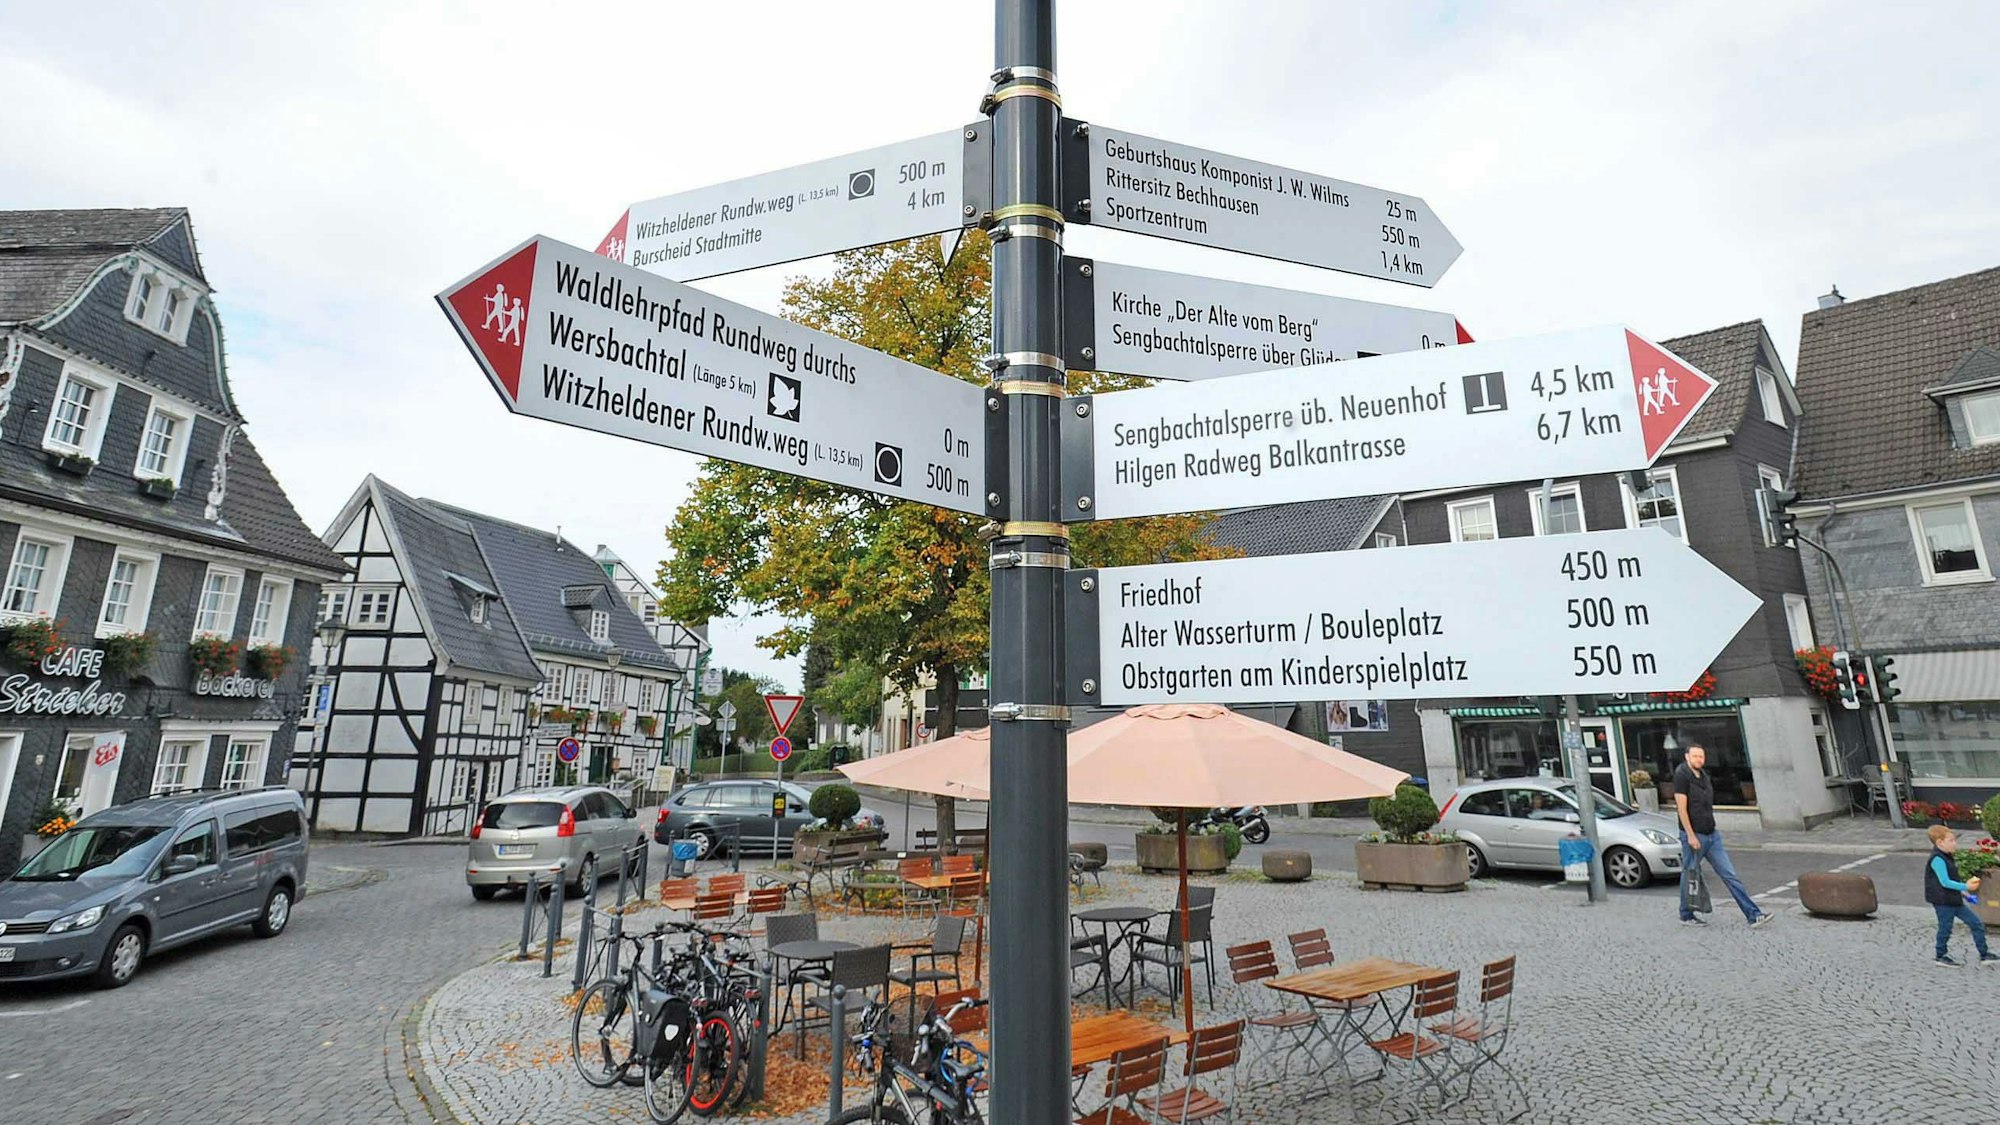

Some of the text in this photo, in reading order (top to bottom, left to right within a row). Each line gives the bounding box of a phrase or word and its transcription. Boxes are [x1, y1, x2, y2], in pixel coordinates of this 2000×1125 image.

[899, 160, 945, 184] 500 m
[1105, 138, 1349, 207] Geburtshaus Komponist J. W. Wilms
[907, 188, 945, 211] 4 km
[1106, 167, 1259, 216] Rittersitz Bechhausen
[636, 212, 717, 241] Witzheldener
[721, 195, 794, 223] Rundw.weg
[810, 188, 824, 200] 13,5
[825, 185, 839, 197] km)
[1106, 197, 1207, 234] Sportzentrum
[1386, 200, 1417, 222] 25 m
[633, 228, 762, 267] Burscheid Stadtmitte
[1382, 224, 1420, 249] 550 m
[1381, 251, 1423, 275] 1,4 km
[556, 260, 856, 385] Waldlehrpfad Rundweg durchs
[1113, 291, 1161, 317] Kirche
[1167, 300, 1203, 323] „Der
[1208, 305, 1237, 328] Alte
[1242, 315, 1273, 333] vom
[550, 311, 756, 399] Wersbachtal (Länge 5 km)
[1113, 323, 1257, 362] Sengbachtalsperre
[1262, 343, 1295, 366] über
[1530, 364, 1615, 402] 4,5 km
[543, 363, 696, 432] Witzheldener
[702, 405, 809, 467] Rundw.weg
[826, 447, 846, 466] 13,5
[847, 451, 863, 472] km)
[1114, 381, 1447, 449] Sengbachtalsperre üb. Neuenhof
[1537, 407, 1622, 445] 6,7 km
[944, 428, 969, 458] 0 m
[926, 462, 969, 497] 500 m
[1115, 437, 1406, 488] Hilgen Radweg Balkantrasse
[1561, 550, 1642, 582] 450 m
[1121, 576, 1202, 608] Friedhof
[1121, 606, 1444, 648] Alter Wasserturm / Bouleplatz
[1567, 596, 1649, 629] 500 m
[1122, 650, 1468, 696] Obstgarten am Kinderspielplatz
[1574, 644, 1657, 677] 550 m
